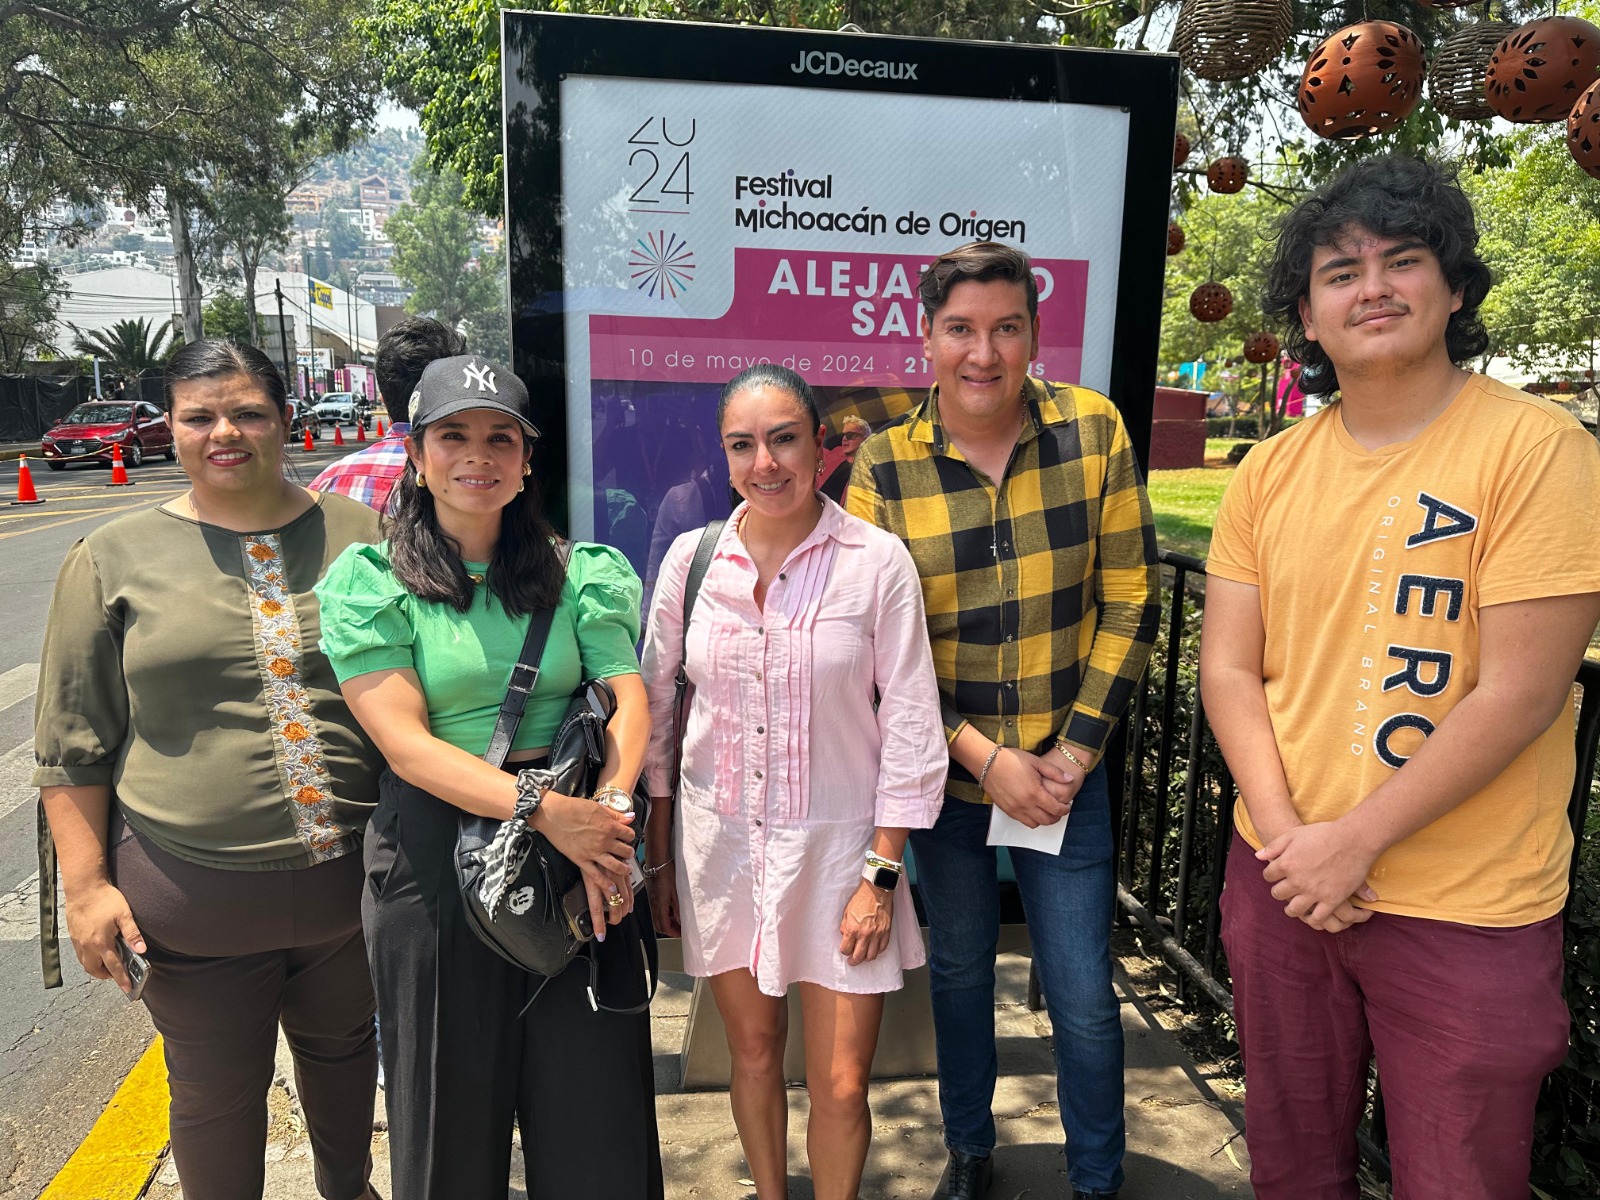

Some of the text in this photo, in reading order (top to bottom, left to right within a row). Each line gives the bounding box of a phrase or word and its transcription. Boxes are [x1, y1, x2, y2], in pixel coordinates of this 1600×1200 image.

[790, 50, 918, 80] JCDecaux
[628, 148, 695, 205] 24
[735, 169, 832, 200] Festival
[735, 199, 1026, 244] Michoacán de Origen
[767, 258, 1055, 303] ALEJAO
[629, 348, 653, 367] 10
[665, 351, 695, 368] de
[782, 354, 812, 371] de
[822, 354, 874, 373] 2024
[1350, 495, 1401, 757] ORIGINAL BRAND
[1372, 490, 1479, 770] AERO
